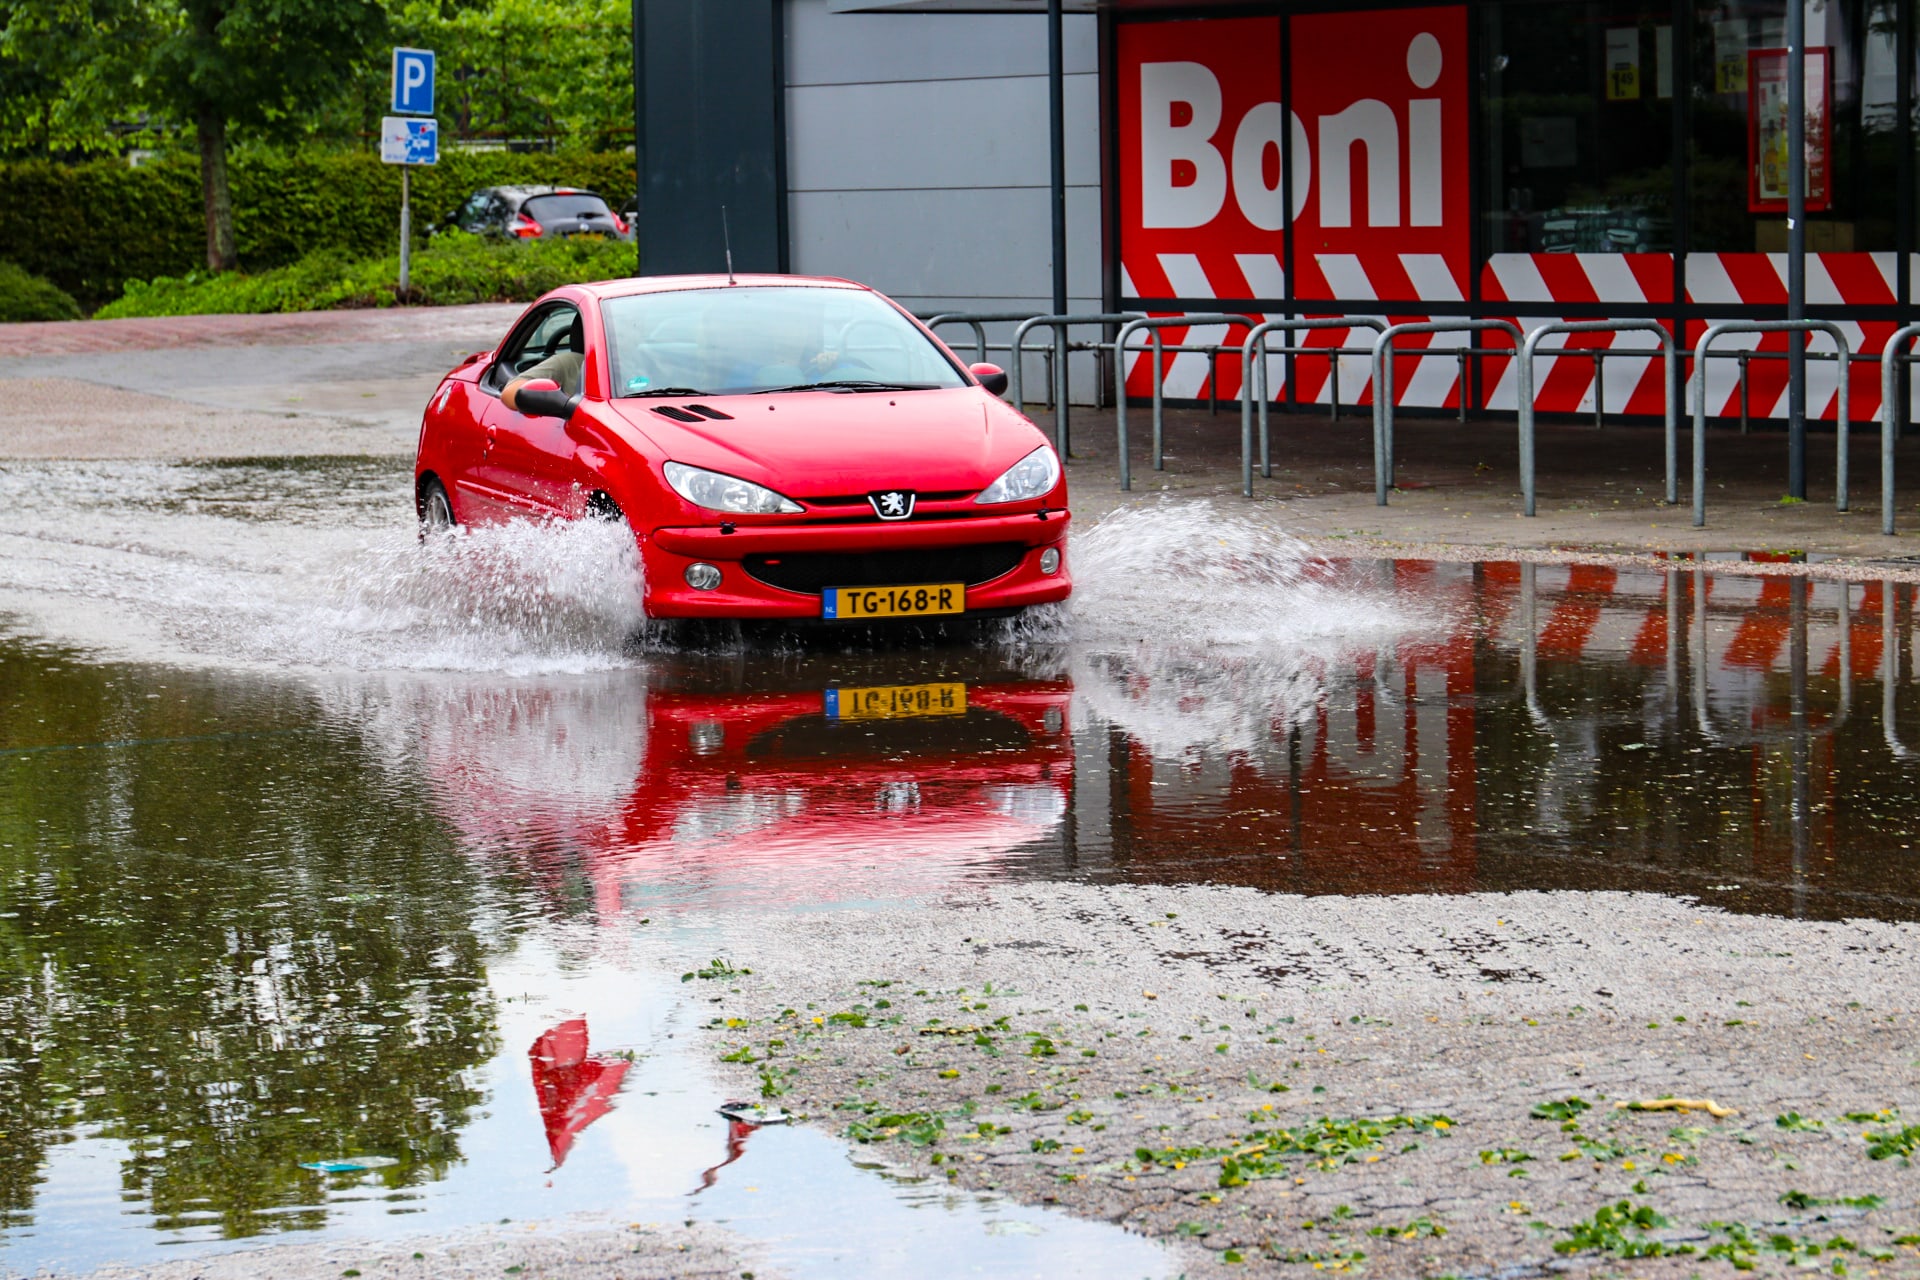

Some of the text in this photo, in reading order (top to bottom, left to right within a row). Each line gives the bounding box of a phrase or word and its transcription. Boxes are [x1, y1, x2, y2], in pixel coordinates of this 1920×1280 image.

[403, 57, 425, 105] P
[1140, 32, 1443, 231] Boni
[847, 588, 953, 614] TG-168-R
